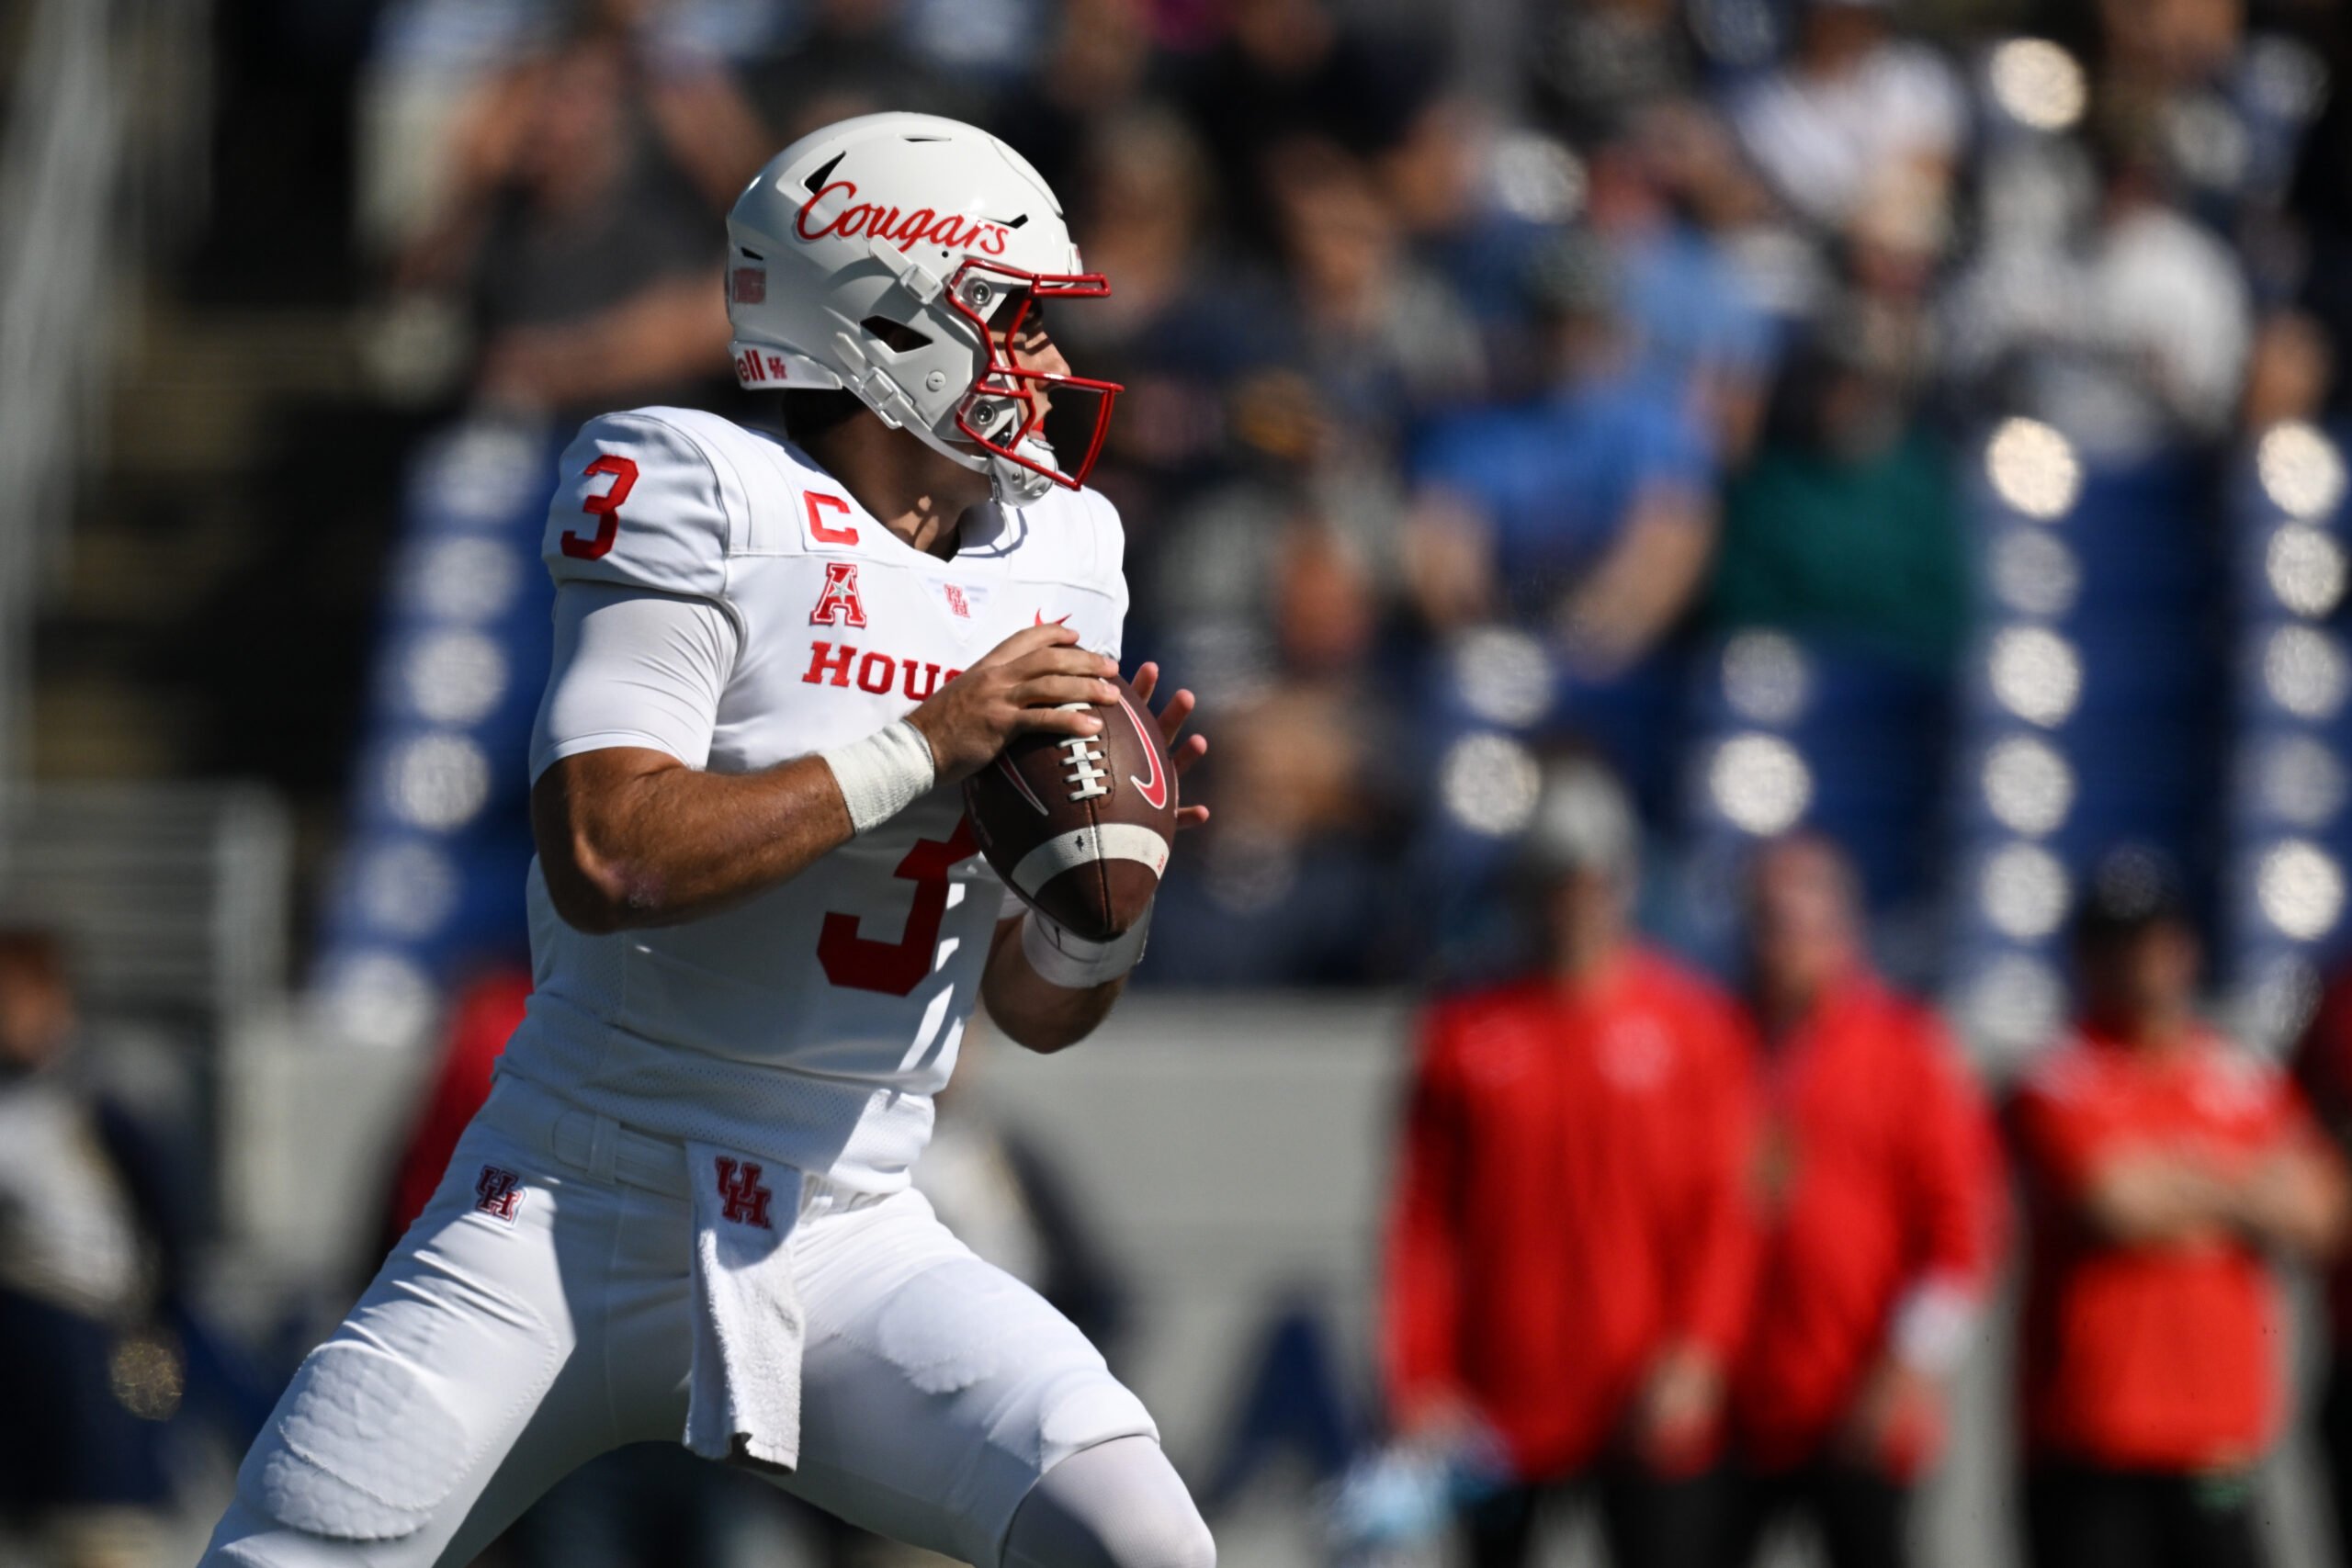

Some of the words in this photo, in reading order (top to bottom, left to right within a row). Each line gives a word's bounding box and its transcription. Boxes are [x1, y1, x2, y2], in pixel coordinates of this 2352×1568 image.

[797, 180, 1010, 255] Cougars
[560, 454, 639, 560] 3
[803, 490, 860, 547] C
